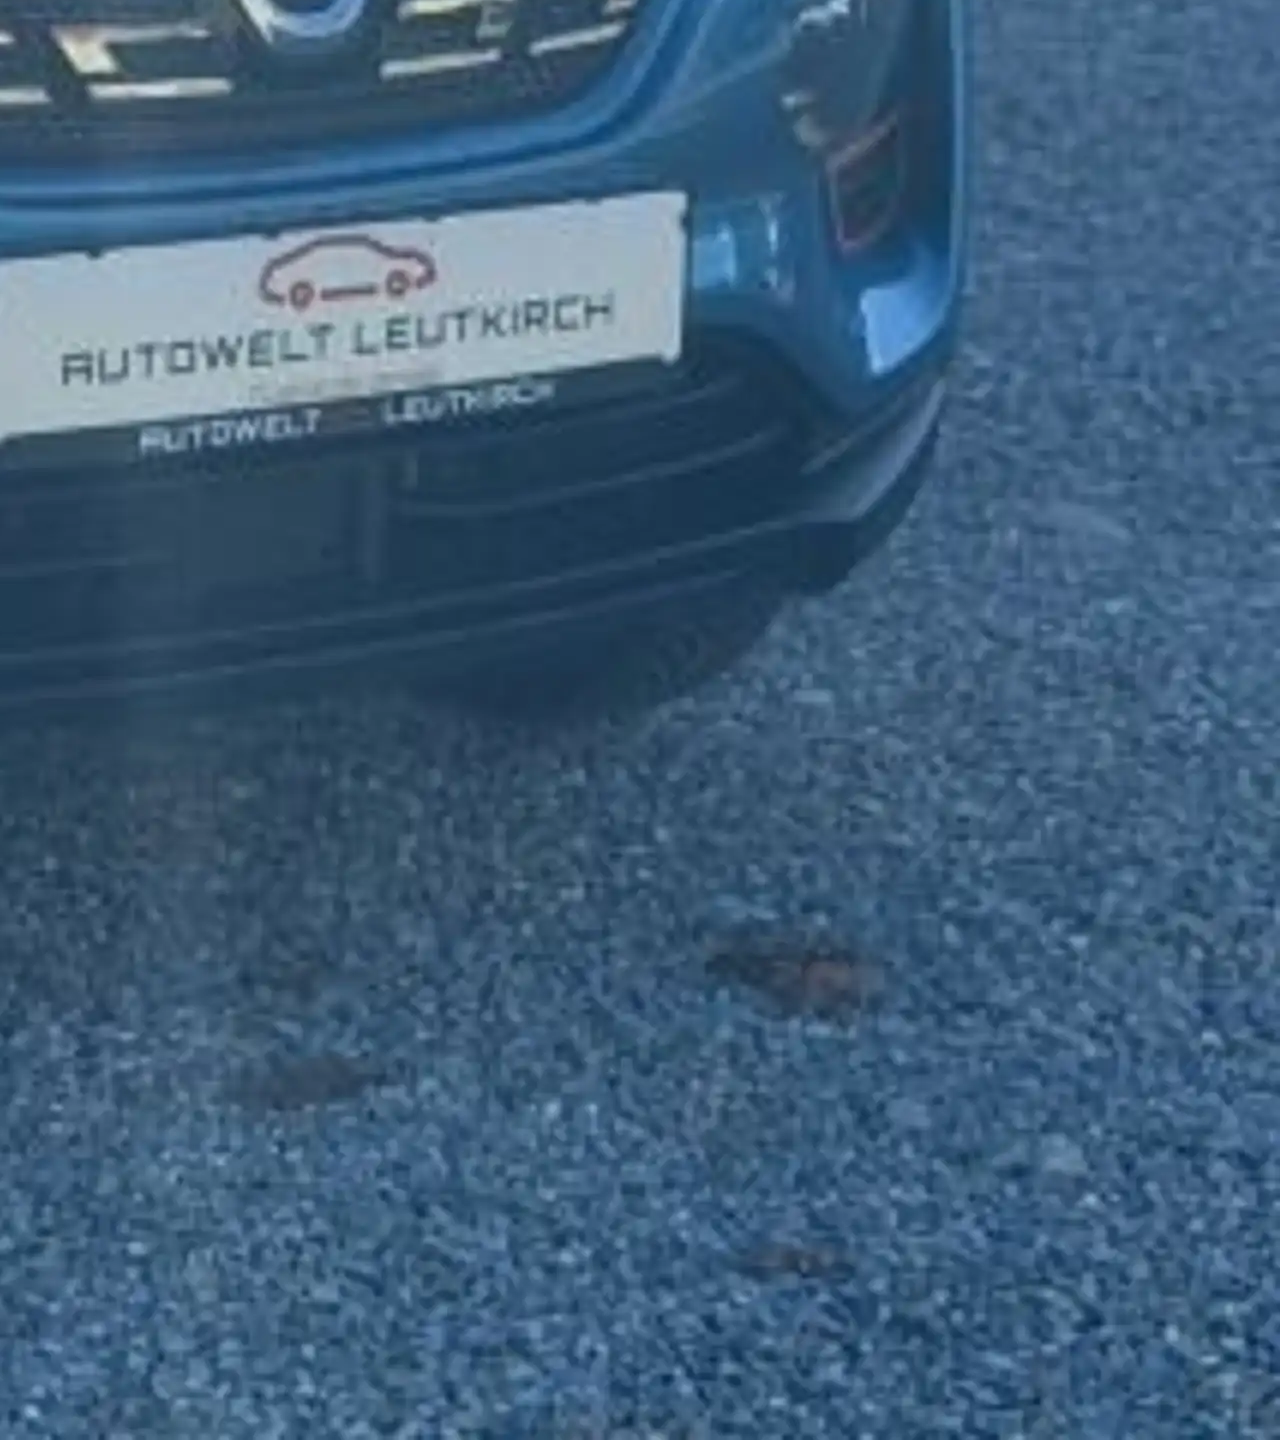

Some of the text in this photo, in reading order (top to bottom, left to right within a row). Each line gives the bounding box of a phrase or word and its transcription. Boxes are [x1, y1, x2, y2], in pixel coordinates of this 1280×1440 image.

[61, 324, 334, 386] AUTOWELT
[351, 293, 615, 357] LEUTKIRCH
[139, 408, 321, 454] AUTOWELT
[383, 379, 557, 426] LEUTKIRCH
